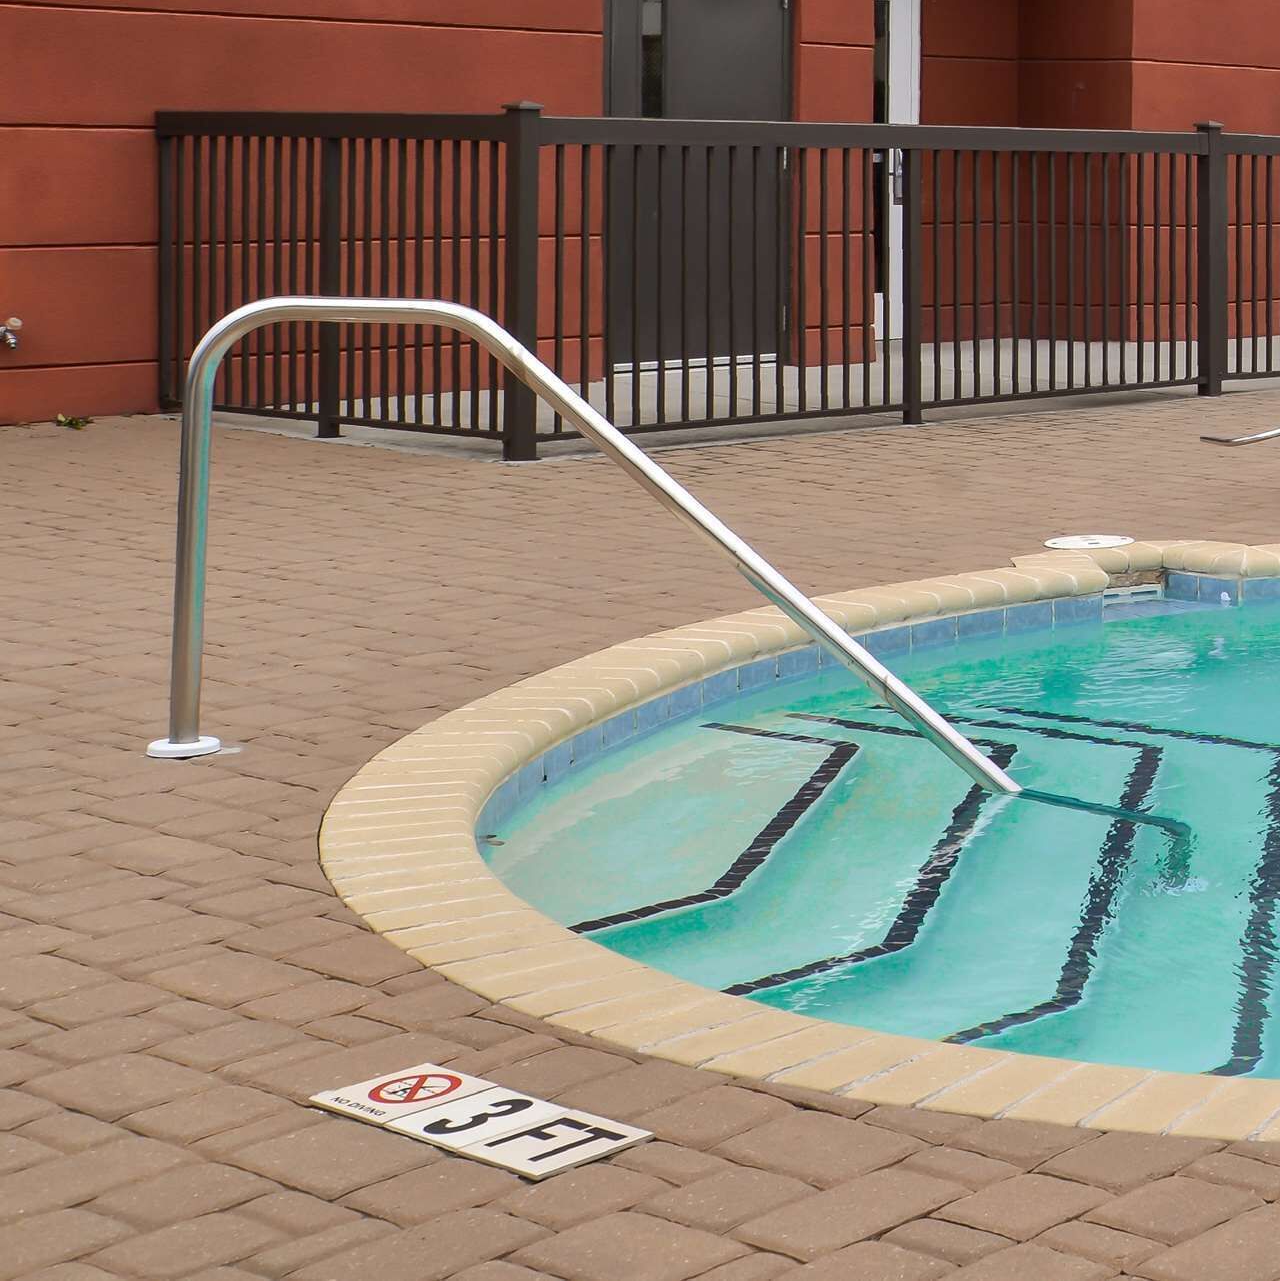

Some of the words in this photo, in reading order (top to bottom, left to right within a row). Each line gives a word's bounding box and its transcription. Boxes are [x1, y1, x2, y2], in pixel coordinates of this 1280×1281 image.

[329, 1096, 351, 1105] NO
[346, 1102, 386, 1116] DIVING
[422, 1098, 534, 1135] 3
[483, 1117, 628, 1162] FT
